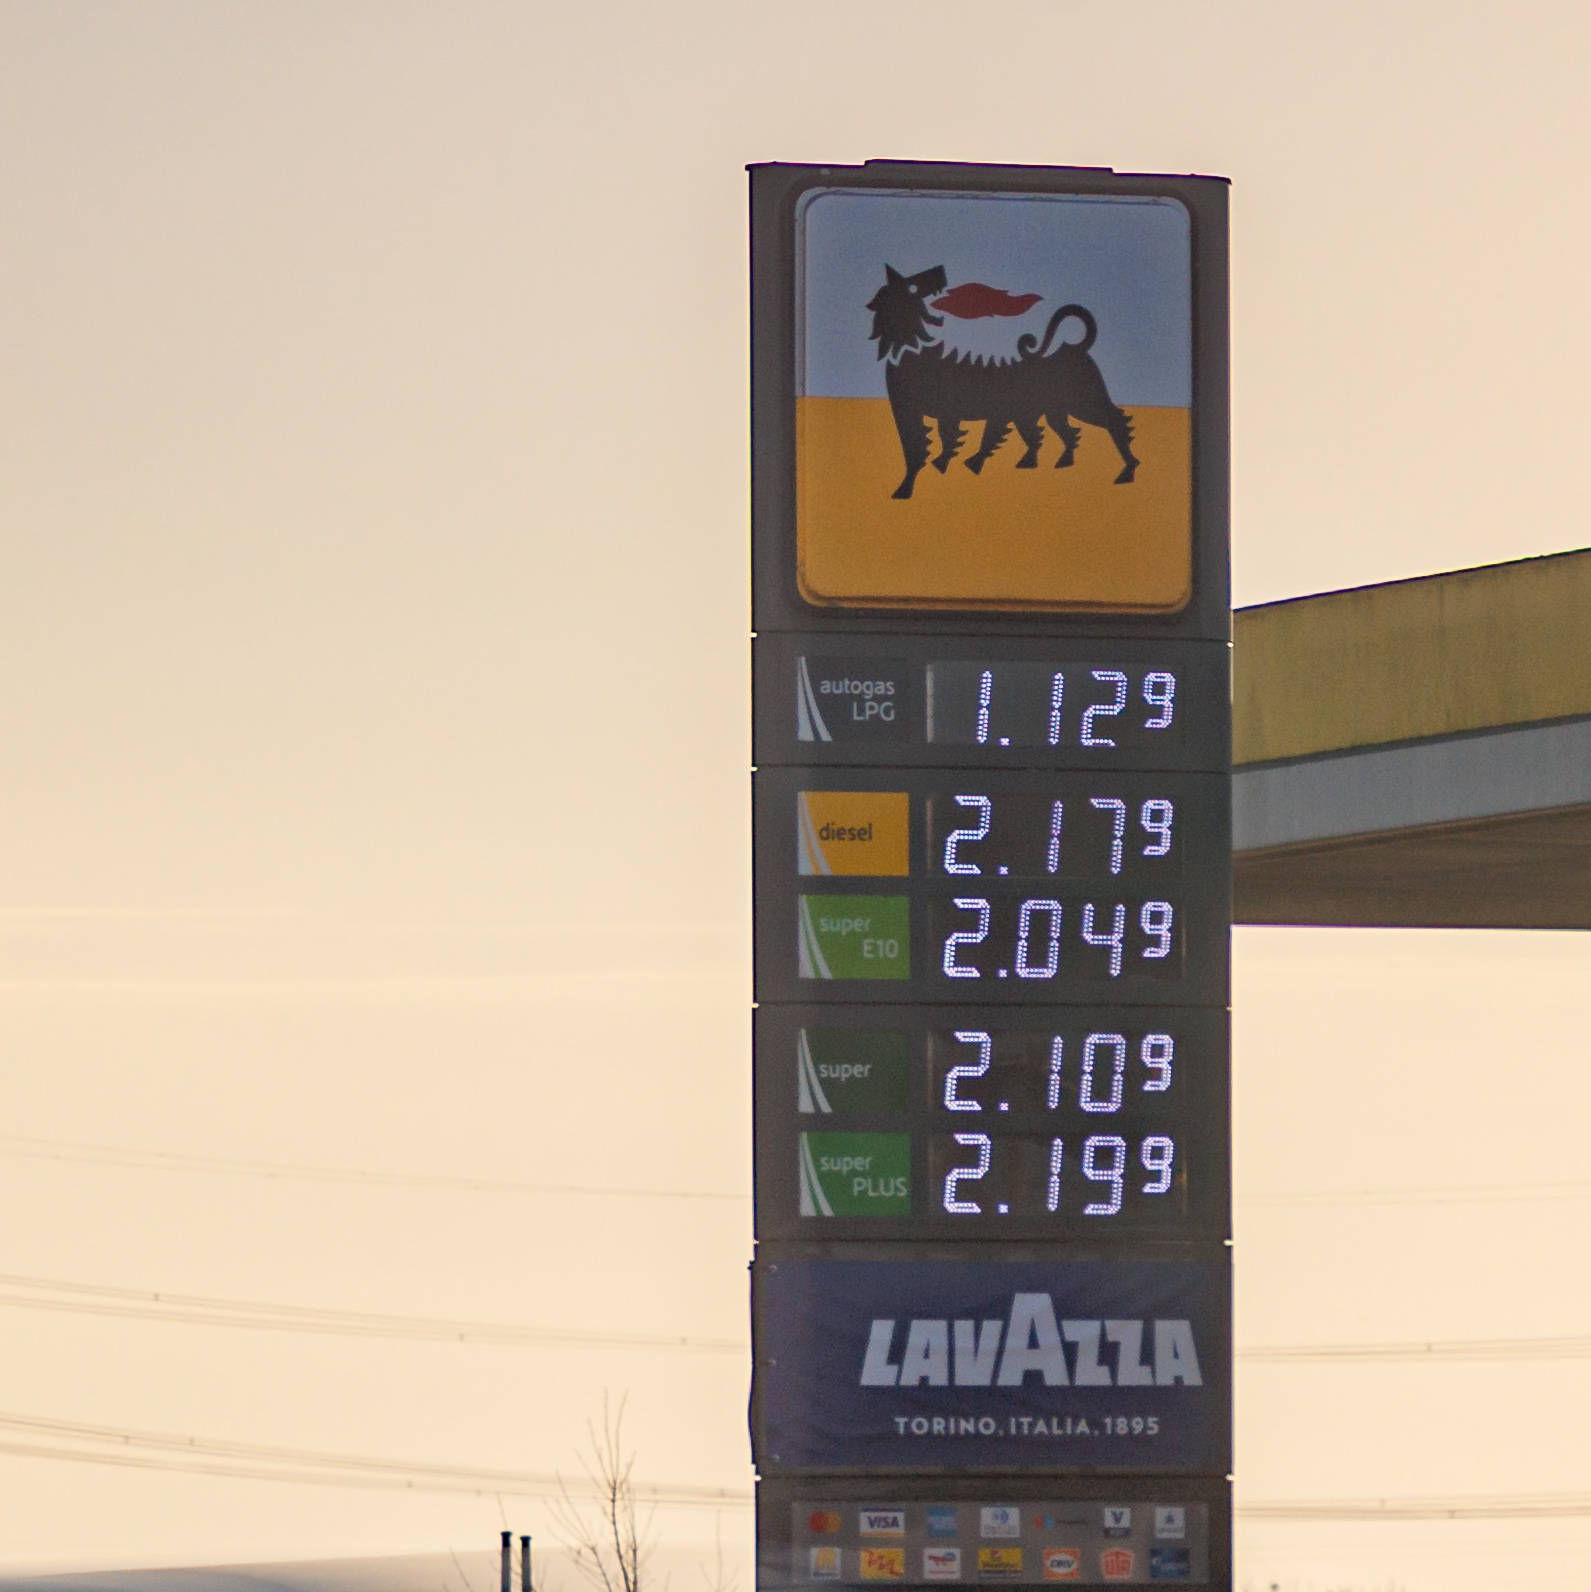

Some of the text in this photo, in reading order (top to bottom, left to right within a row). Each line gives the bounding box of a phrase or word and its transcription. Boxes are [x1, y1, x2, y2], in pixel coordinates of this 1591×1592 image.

[819, 677, 895, 698] autogas
[852, 702, 895, 721] LPG
[975, 670, 1176, 747] 1.129
[819, 821, 873, 842] diesel
[943, 795, 1174, 875] 2.179
[819, 916, 871, 936] super
[942, 898, 1174, 978] 2.049
[862, 939, 899, 959] E10
[819, 1061, 872, 1081] super
[943, 1031, 1175, 1113] 2.109
[820, 1154, 871, 1173] super
[942, 1133, 1175, 1216] 2.199
[852, 1176, 908, 1197] PLUS
[858, 1292, 1204, 1387] LAVAZZA
[1104, 1417, 1160, 1436] 1895
[867, 1516, 899, 1529] VISA
